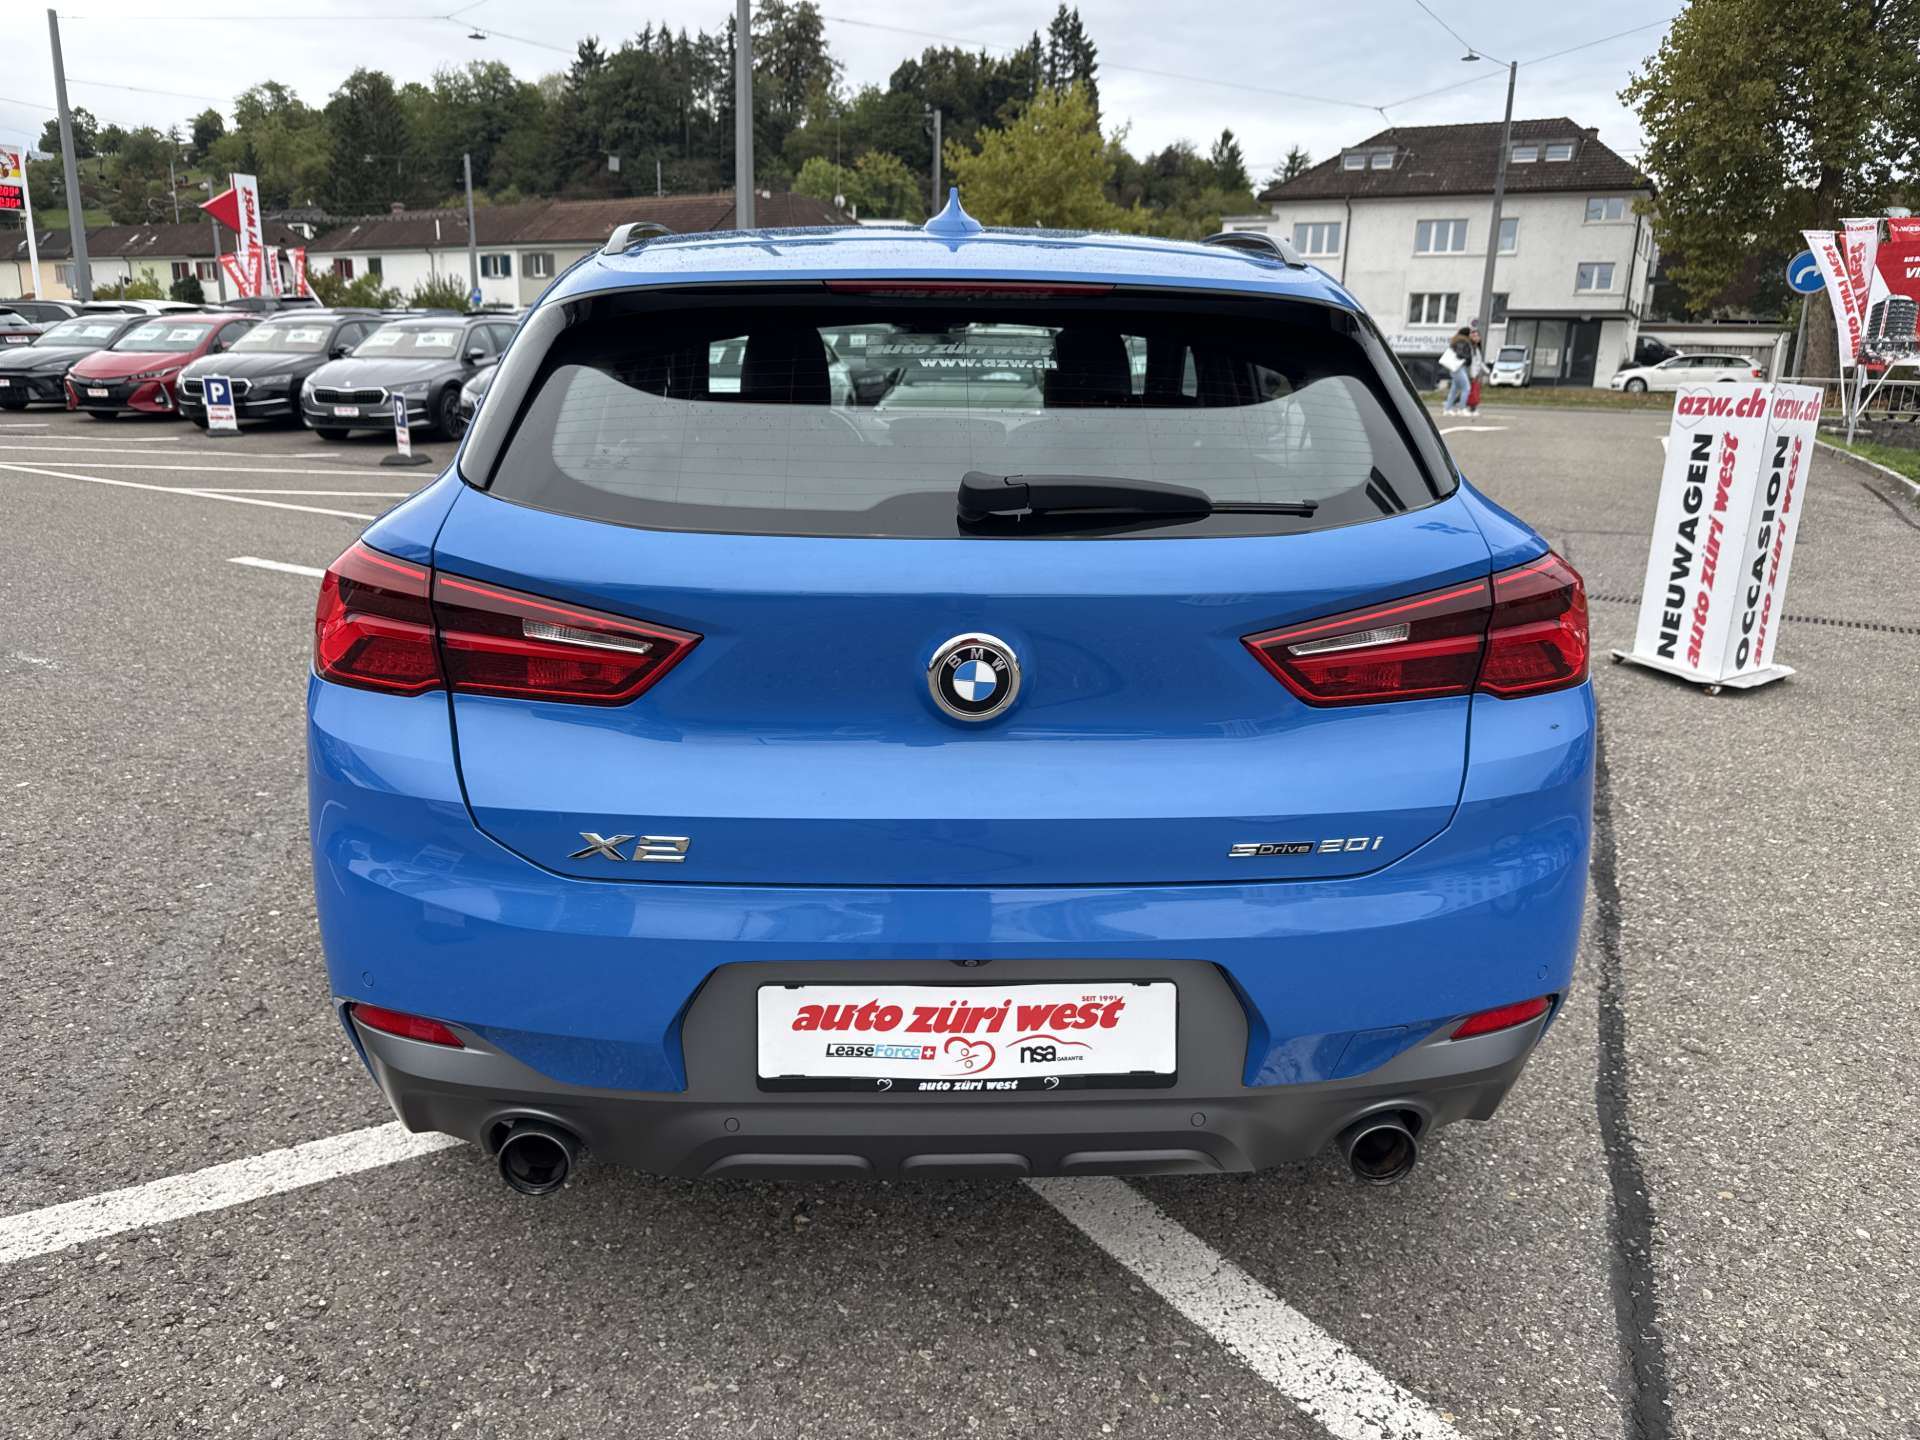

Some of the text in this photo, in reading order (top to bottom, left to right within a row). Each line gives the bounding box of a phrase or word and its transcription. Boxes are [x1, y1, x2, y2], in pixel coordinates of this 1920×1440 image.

[919, 358, 1057, 368] www.azw.ch
[210, 383, 224, 403] P
[1676, 388, 1766, 418] azw.ch
[1772, 392, 1820, 422] azw.ch
[1657, 433, 1713, 659] NEUWAGEN
[1687, 431, 1739, 669] auto züri west
[1736, 436, 1789, 670] OCCASION
[1753, 435, 1802, 667] auto züri west
[947, 648, 1006, 672] BMW
[567, 832, 691, 862] X2
[1317, 836, 1384, 854] 20i
[792, 997, 1126, 1034] auto züri west
[825, 1043, 922, 1060] LeaseForce
[1020, 1045, 1057, 1064] nsa
[918, 1079, 1018, 1091] auto züri west
